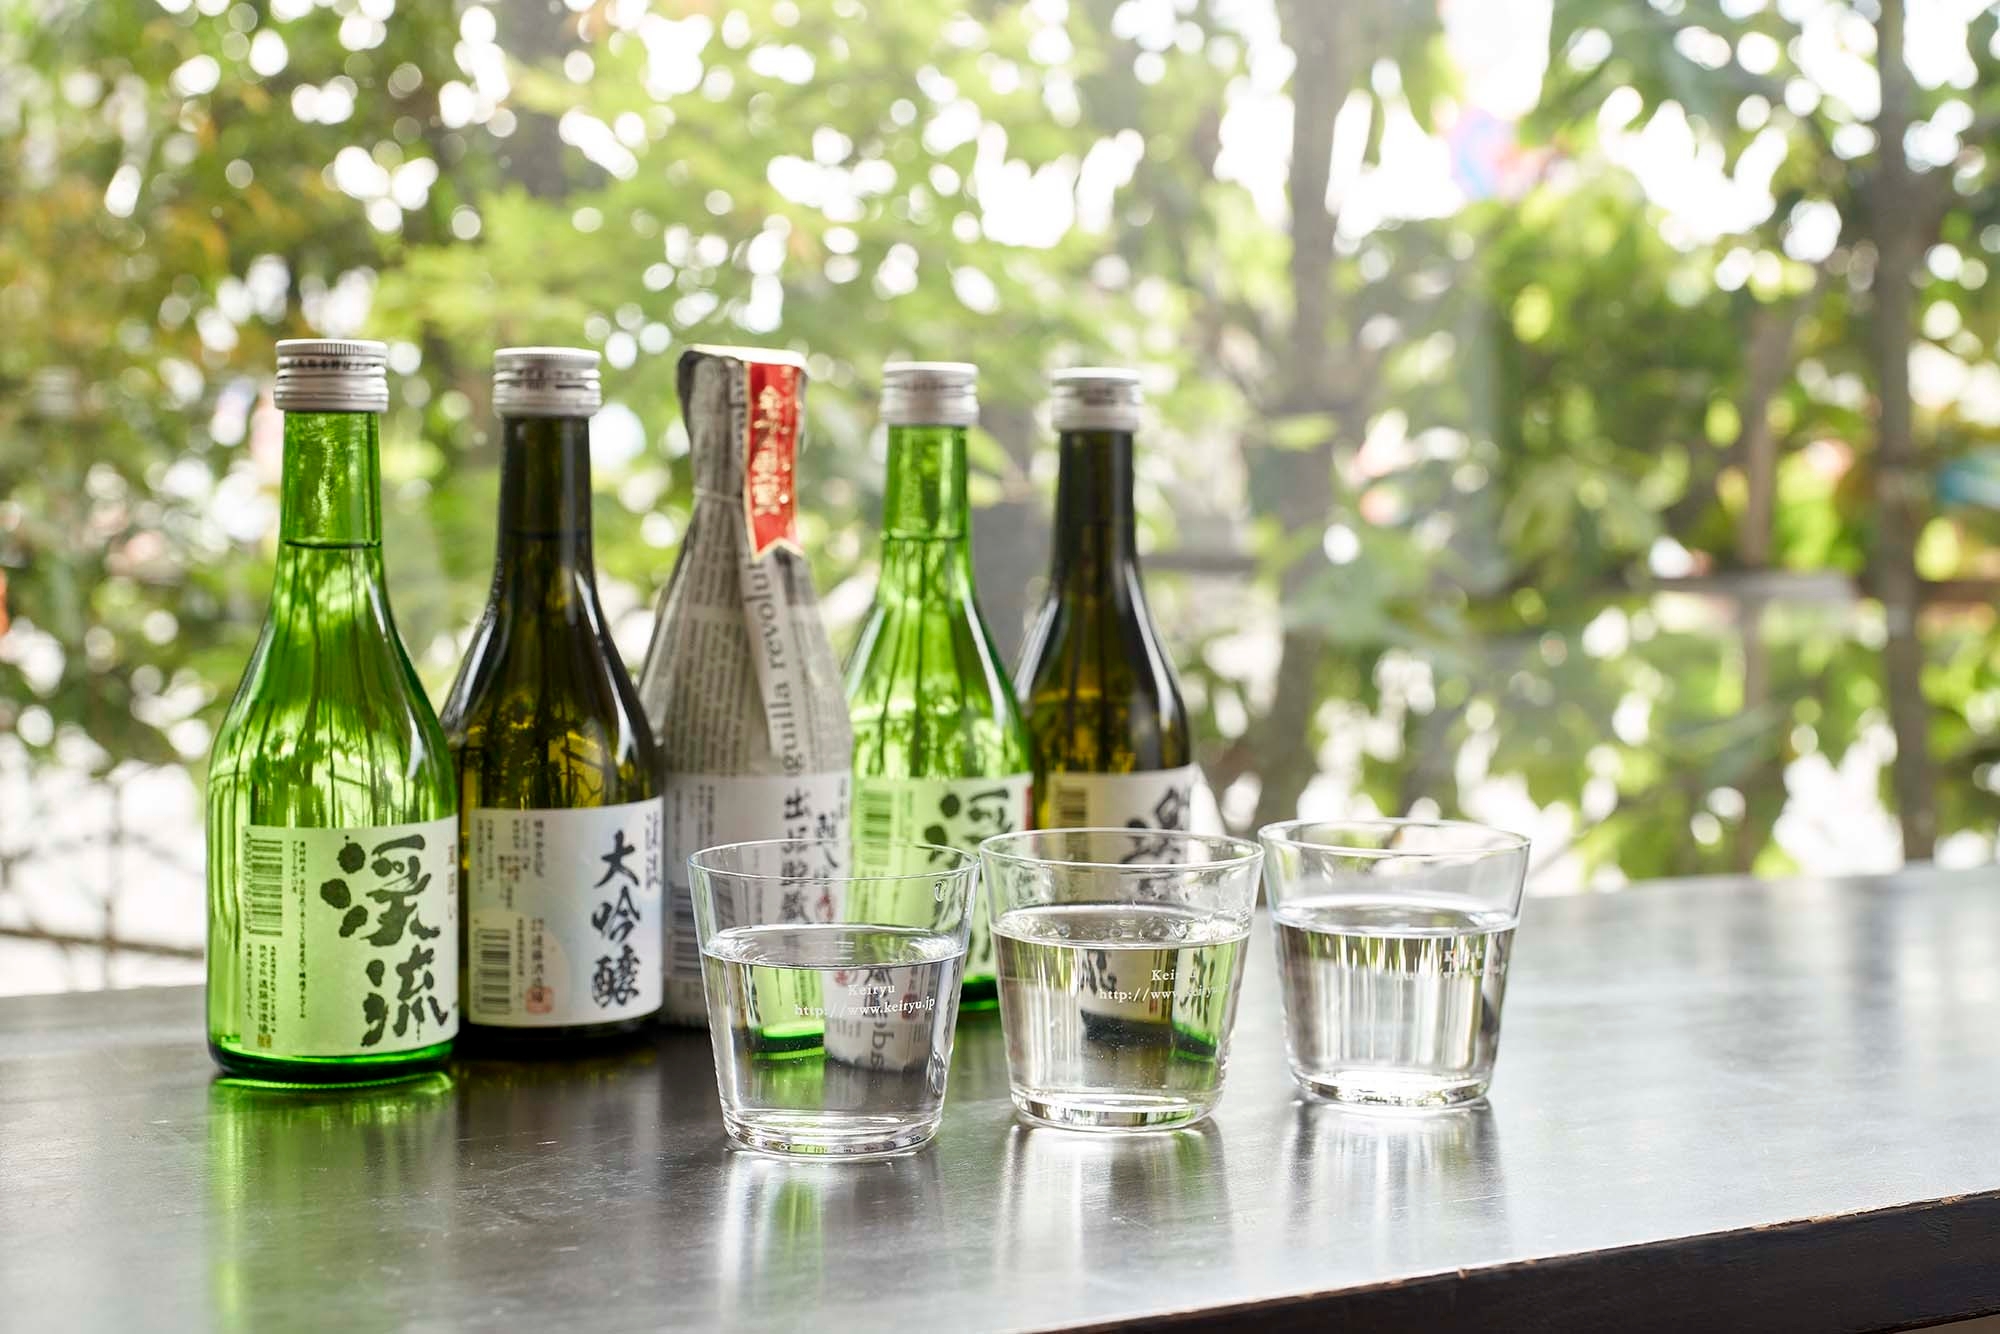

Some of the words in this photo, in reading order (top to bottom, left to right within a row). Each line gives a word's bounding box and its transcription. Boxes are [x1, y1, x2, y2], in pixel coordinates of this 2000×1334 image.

[743, 553, 786, 670] revolut
[591, 829, 642, 1009] 大吟醸
[794, 995, 936, 1018] http://www.keiryu.jp
[847, 982, 896, 998] Keiryu
